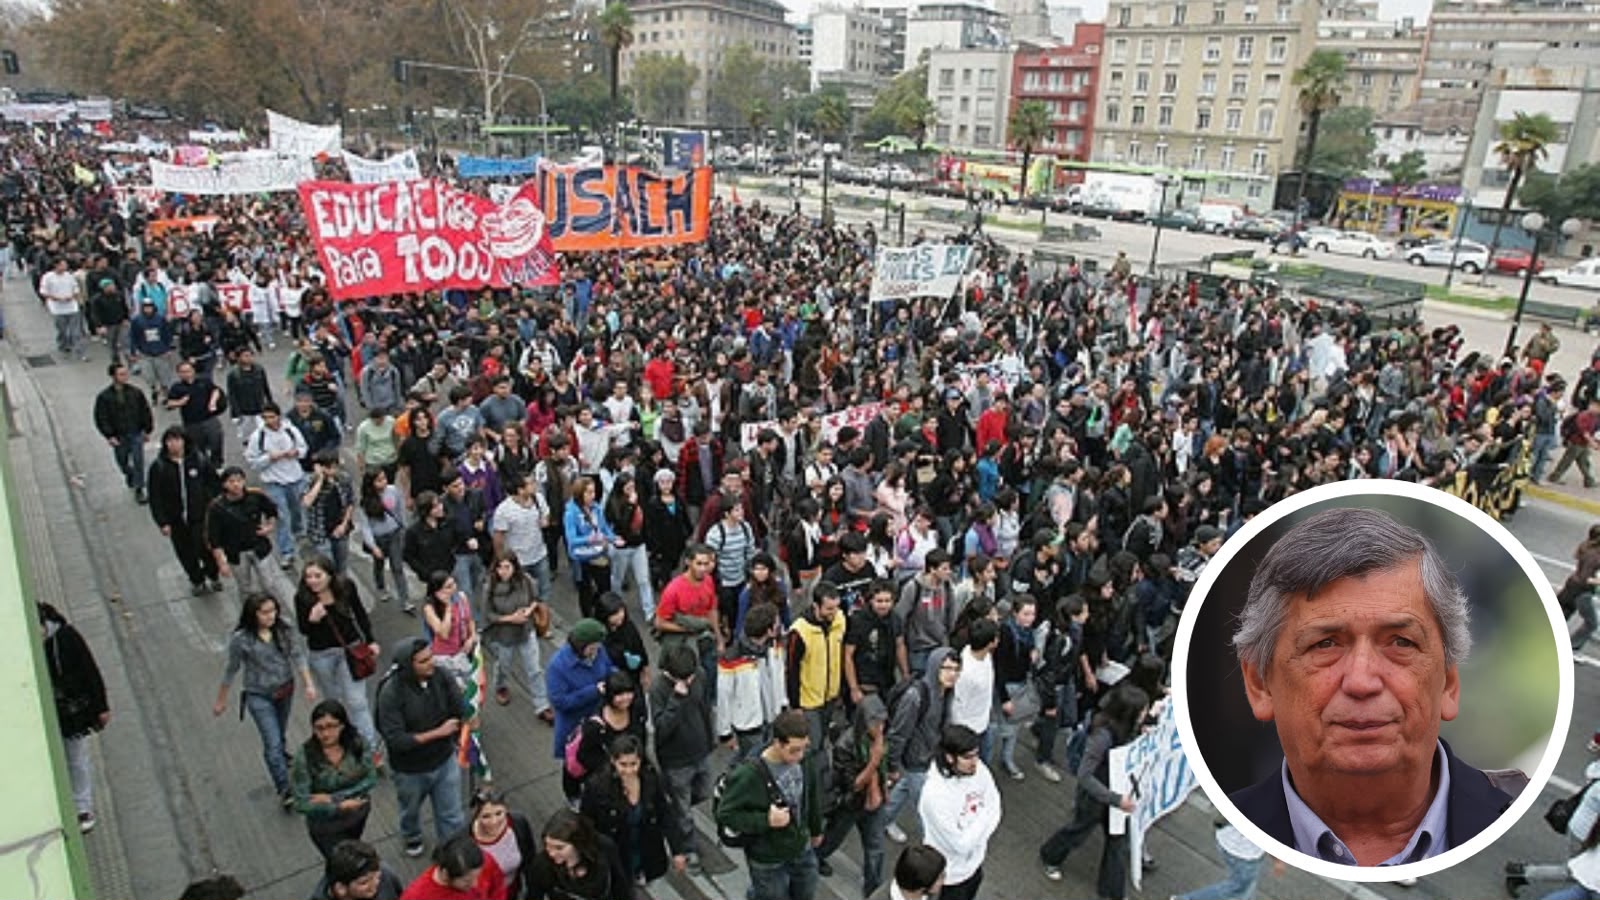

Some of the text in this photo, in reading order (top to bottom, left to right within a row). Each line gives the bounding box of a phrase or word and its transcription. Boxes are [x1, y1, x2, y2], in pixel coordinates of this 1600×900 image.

[310, 177, 479, 239] EDUCACI
[537, 167, 696, 239] USACH
[323, 245, 383, 289] Para
